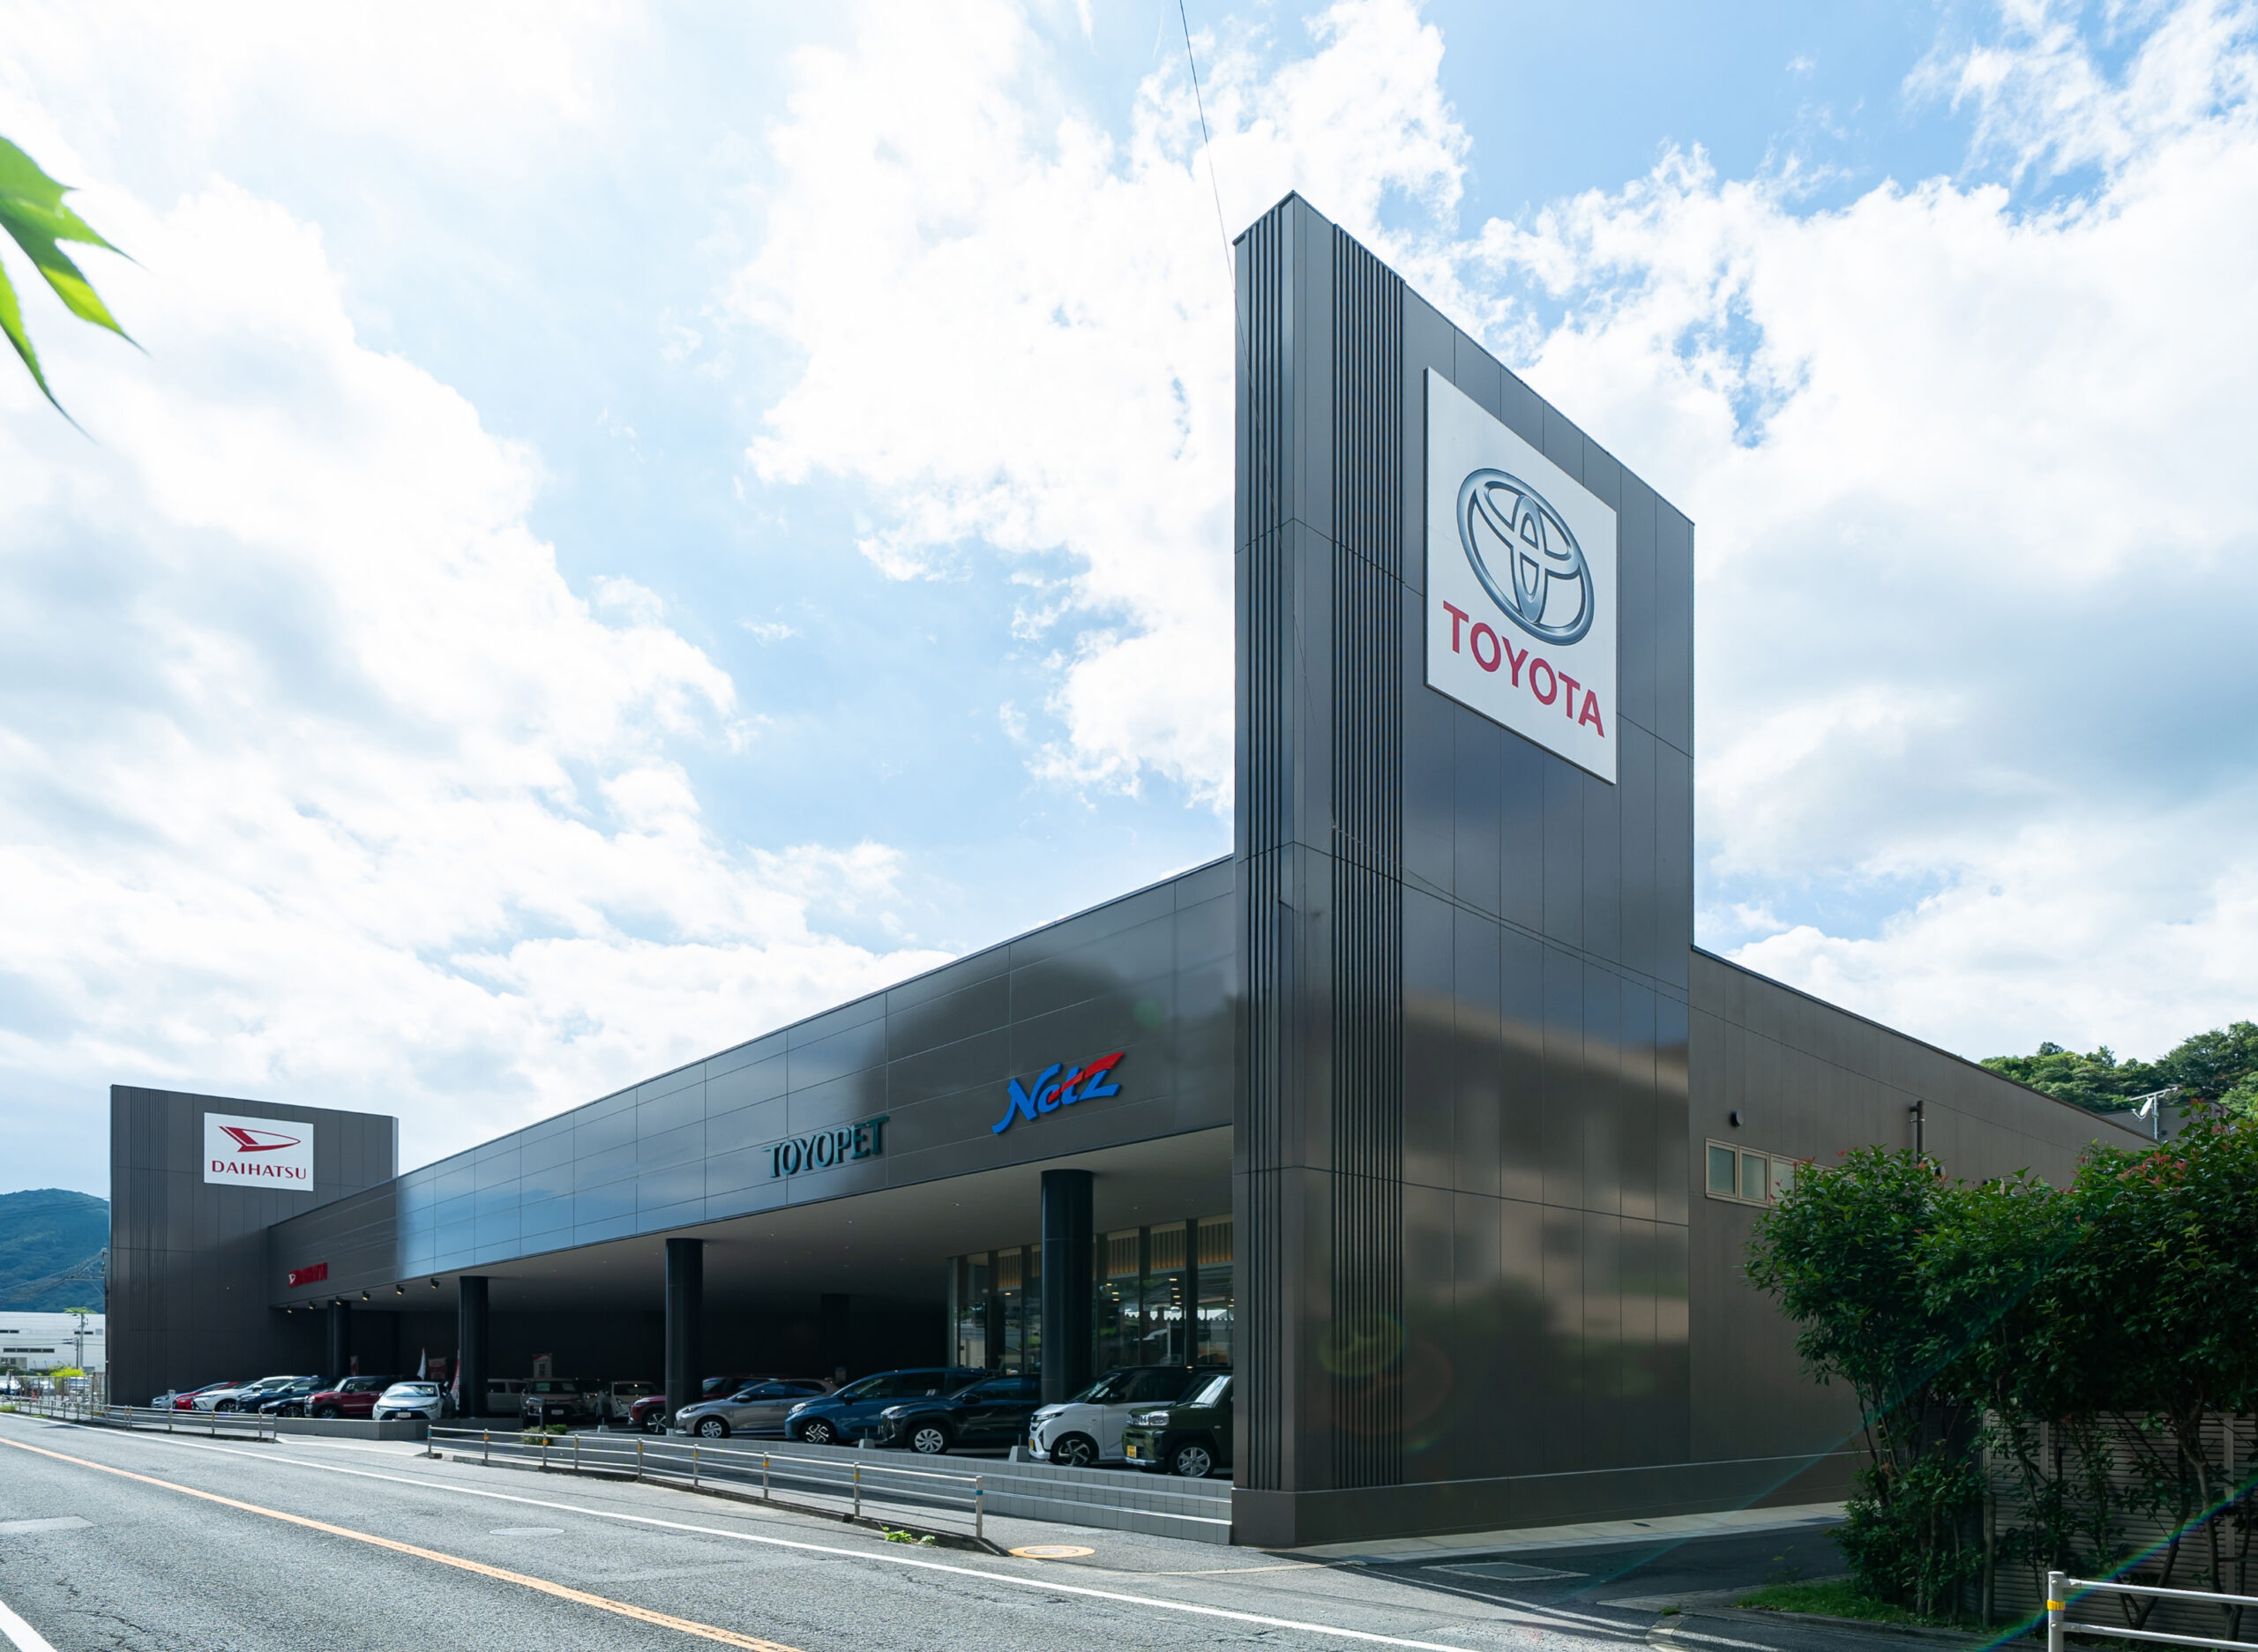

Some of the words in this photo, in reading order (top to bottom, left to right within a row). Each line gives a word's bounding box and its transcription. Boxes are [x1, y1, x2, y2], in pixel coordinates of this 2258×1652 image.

[1443, 601, 1604, 737] TOYOTA
[991, 1051, 1125, 1134] Netz
[212, 1160, 307, 1180] DAIHATSU
[762, 1115, 891, 1178] TOYOPET
